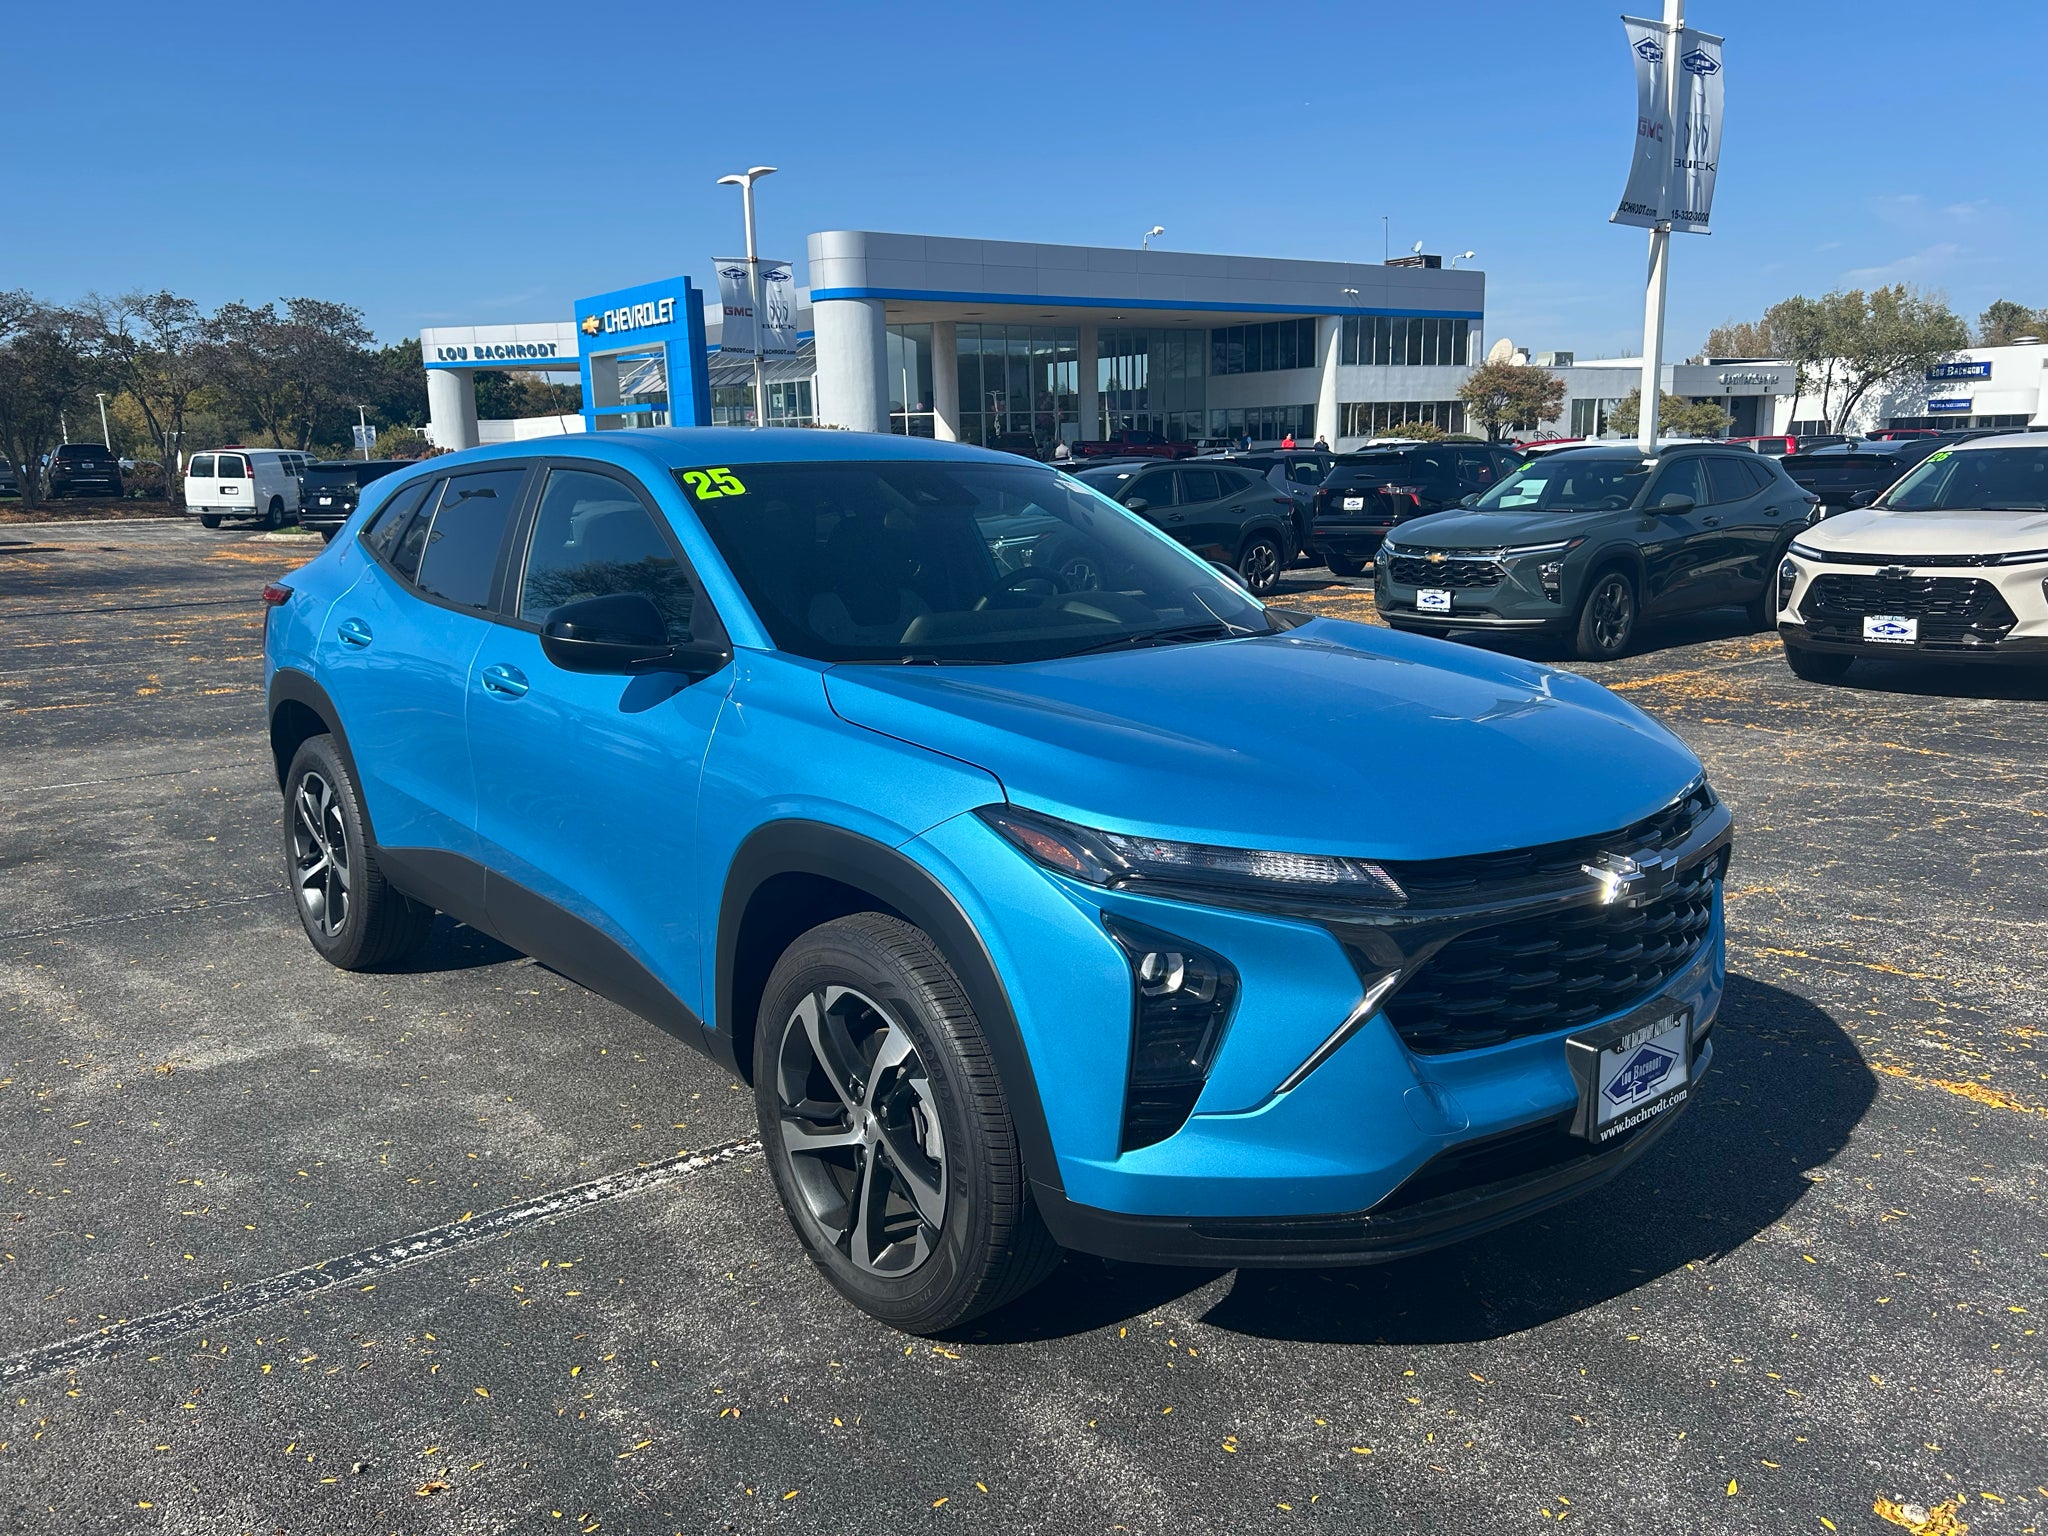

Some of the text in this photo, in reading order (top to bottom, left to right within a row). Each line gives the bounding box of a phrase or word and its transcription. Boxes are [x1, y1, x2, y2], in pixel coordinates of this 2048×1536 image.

[1638, 116, 1663, 143] GMC
[1674, 158, 1716, 172] BUICK
[1618, 201, 1657, 217] ACHRODT.com
[1671, 209, 1710, 223] 15-332-3000
[604, 297, 675, 333] CHEVROLET
[723, 306, 753, 317] GMC
[437, 343, 557, 361] LOU BACHRODT
[682, 467, 746, 500] 25
[1621, 1070, 1632, 1086] LOU
[1599, 1089, 1688, 1141] www.bachrodt.com
